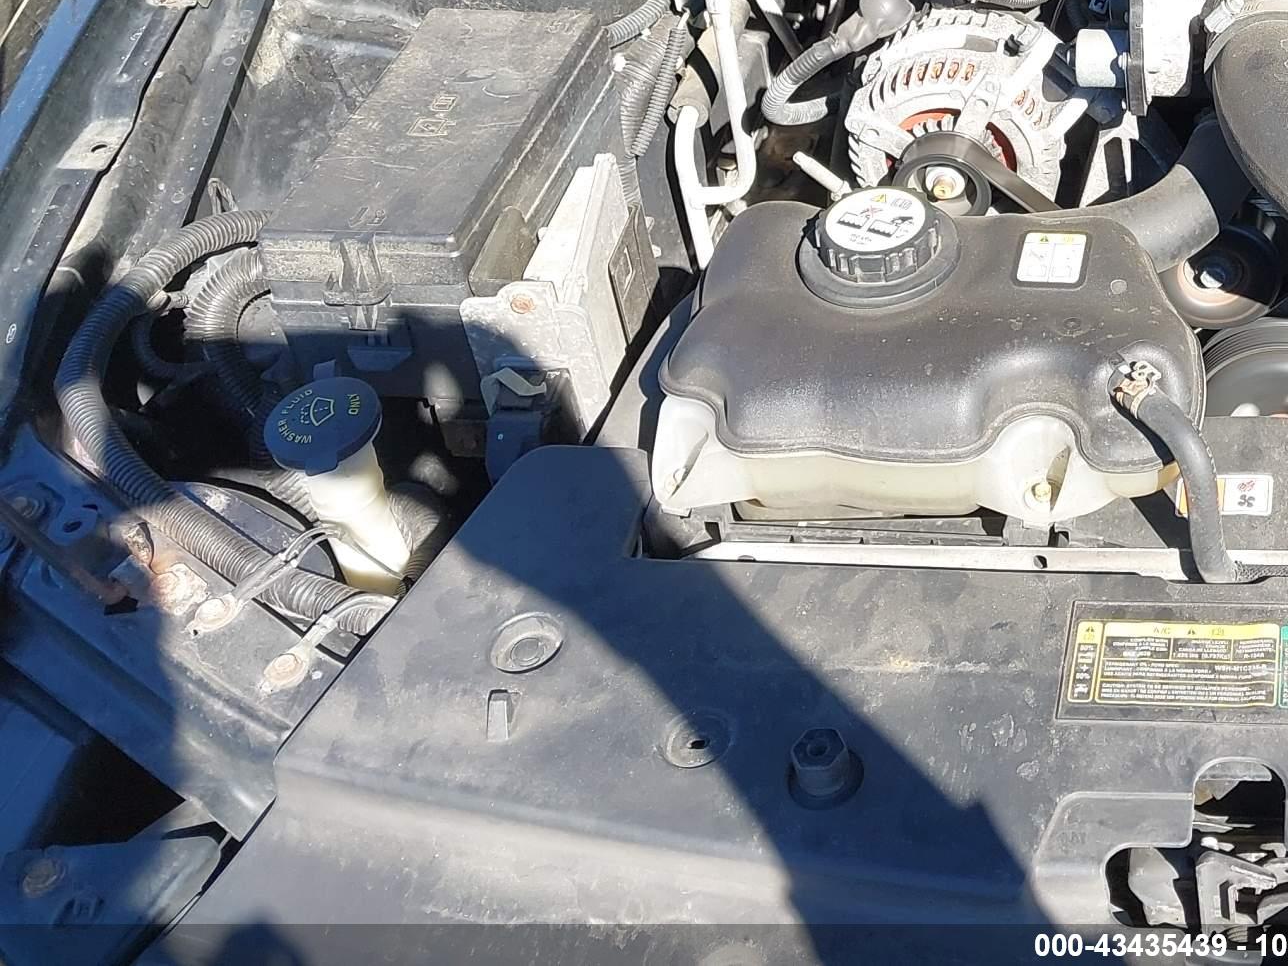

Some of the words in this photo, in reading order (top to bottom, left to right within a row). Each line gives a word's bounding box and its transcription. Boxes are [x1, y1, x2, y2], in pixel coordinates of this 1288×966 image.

[281, 388, 314, 415] FLUID
[346, 393, 361, 415] ONLY
[277, 418, 313, 445] WASHER
